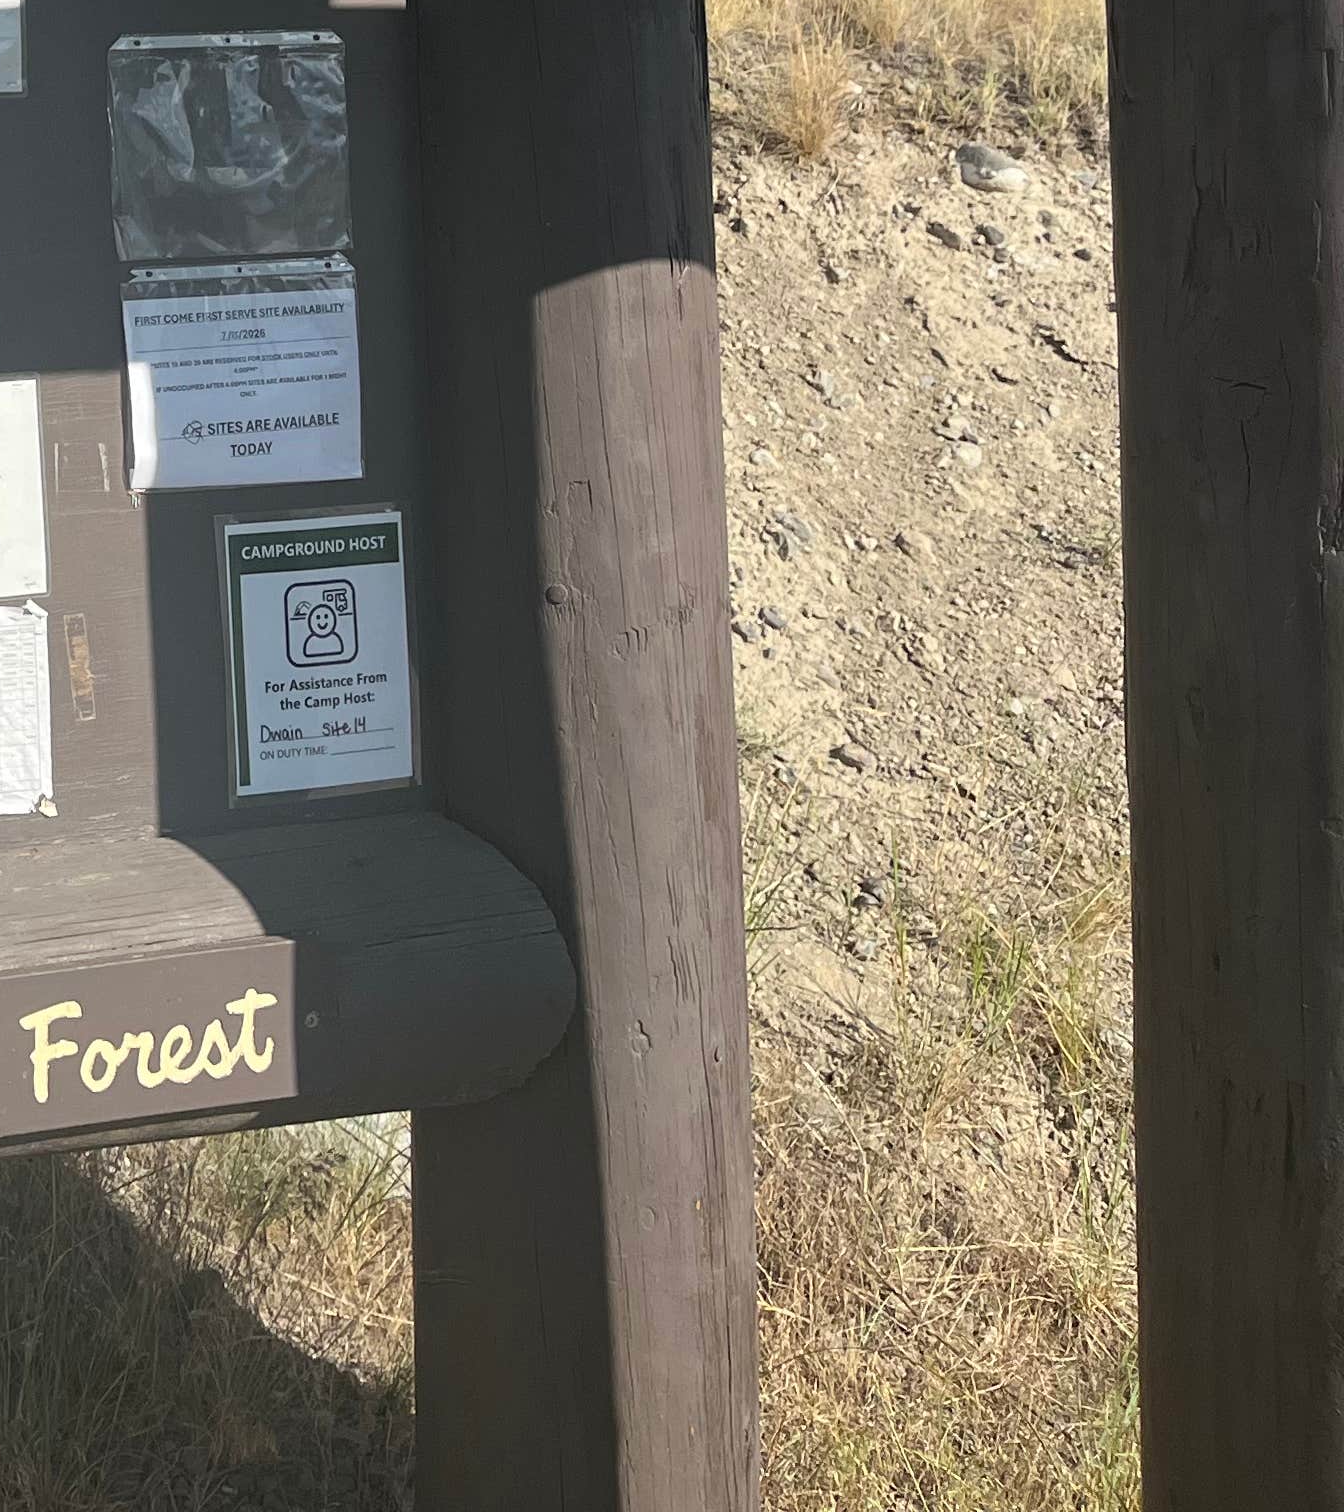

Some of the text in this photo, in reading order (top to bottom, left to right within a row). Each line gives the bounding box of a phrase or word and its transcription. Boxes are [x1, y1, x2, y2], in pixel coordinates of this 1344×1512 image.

[134, 302, 345, 326] FIRST COME FIRST SERVE SITE AVAILABILITY
[208, 412, 339, 435] SITES ARE AVAILABLE
[231, 441, 272, 457] TODAY
[241, 535, 386, 560] CAMPGROUND HOST
[265, 671, 387, 693] For Assistance From
[280, 691, 375, 711] the Camp Host:
[260, 725, 302, 742] Dwain
[322, 721, 350, 737] Site
[259, 745, 328, 760] ON DUTY TIME:
[21, 988, 277, 1106] Forest
